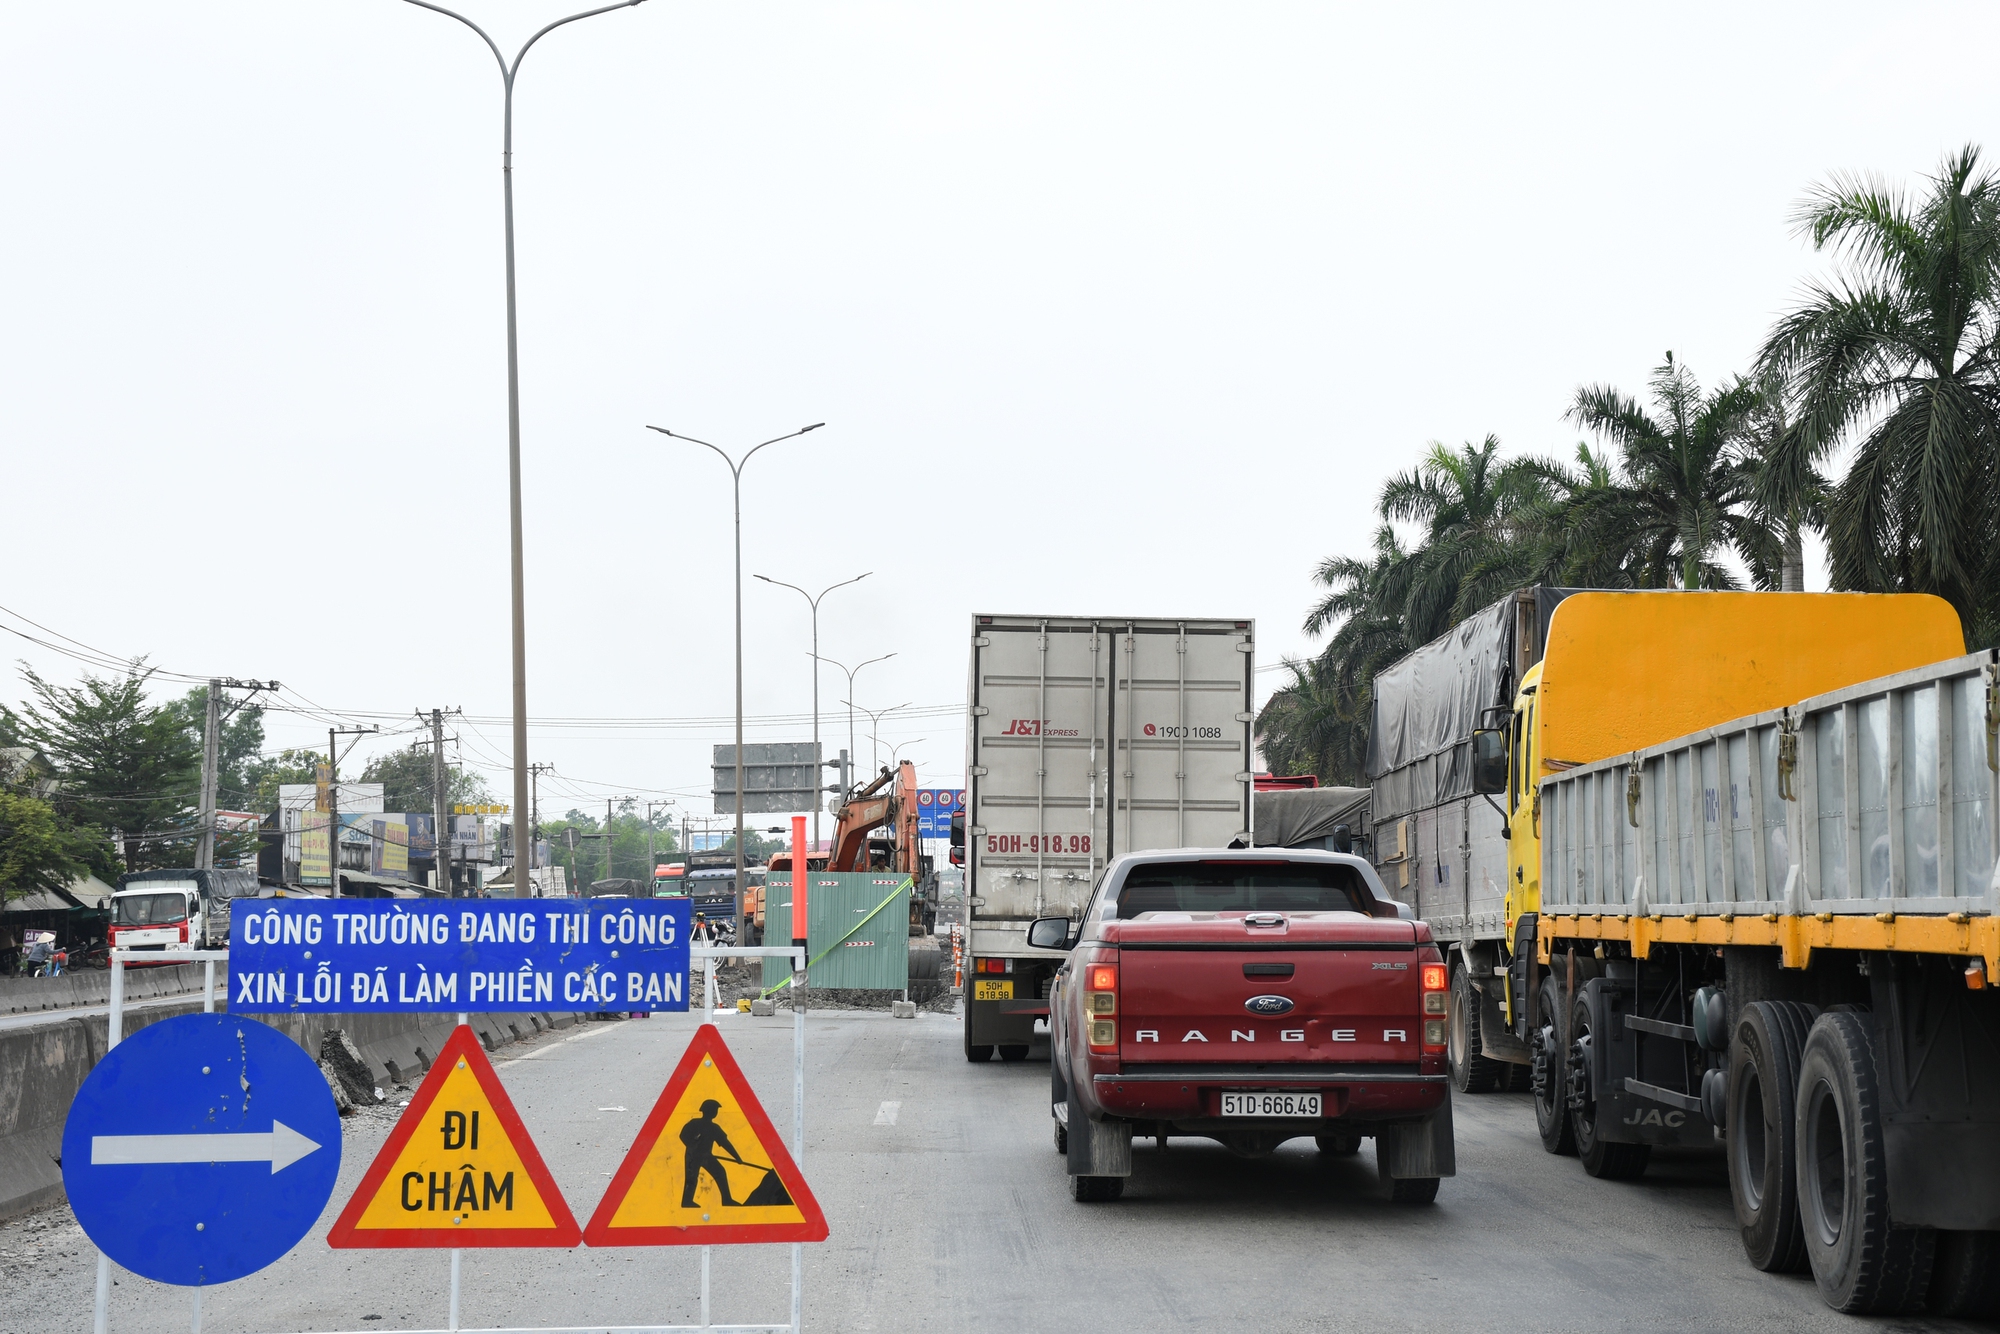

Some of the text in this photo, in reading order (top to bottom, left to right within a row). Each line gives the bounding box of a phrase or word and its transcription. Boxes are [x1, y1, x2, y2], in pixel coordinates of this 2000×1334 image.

[1001, 719, 1079, 737] J&T EXPRESS
[1159, 726, 1221, 739] 1900 1088
[922, 793, 930, 803] 60
[941, 793, 949, 802] 60
[988, 834, 1092, 854] 50H-918.98
[243, 905, 677, 945] CÔNG TRƯỜNG ĐANG THI CÔNG
[236, 957, 682, 1009] XIN LỖI ĐÃ LÀM PHIỀN CÁC BẠN
[985, 982, 1003, 990] 50H
[979, 990, 1010, 1000] 918.98
[1256, 998, 1283, 1011] Ford
[1136, 1029, 1407, 1043] RANGER
[1224, 1095, 1319, 1116] 51D-666.49
[1623, 1108, 1686, 1128] JAC
[440, 1110, 479, 1150] ĐI
[401, 1163, 514, 1219] CHẬM
